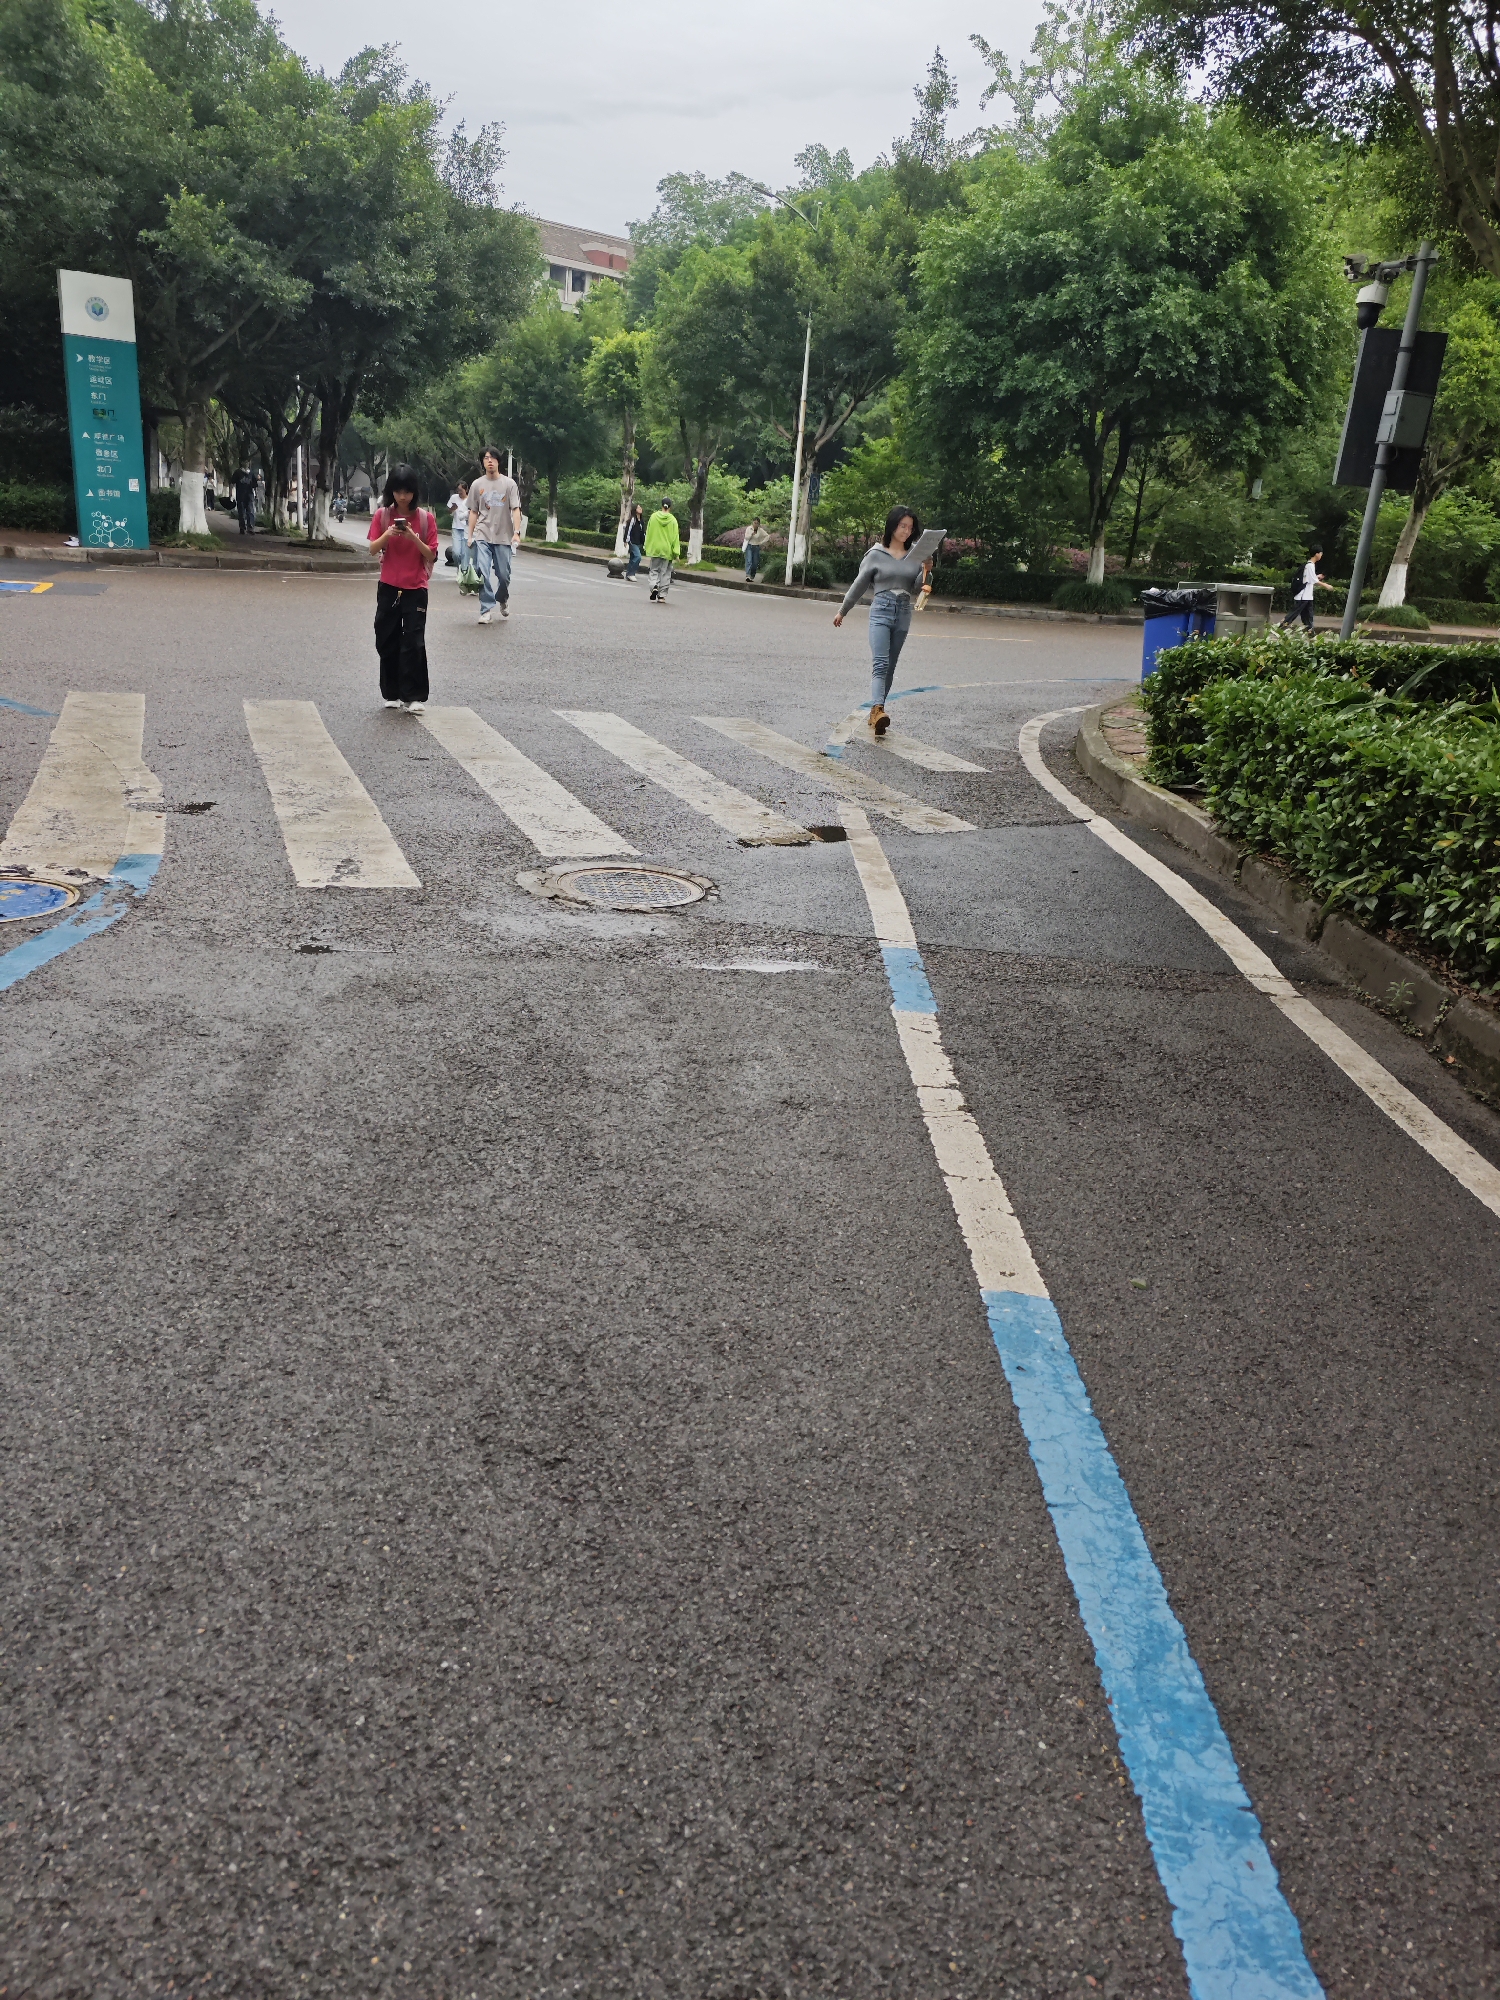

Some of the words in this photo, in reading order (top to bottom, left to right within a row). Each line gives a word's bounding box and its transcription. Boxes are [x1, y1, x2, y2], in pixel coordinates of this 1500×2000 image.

[88, 354, 111, 364] 教学区
[91, 392, 107, 401] 东门
[97, 465, 112, 474] 北门
[98, 488, 121, 498] 图书馆
